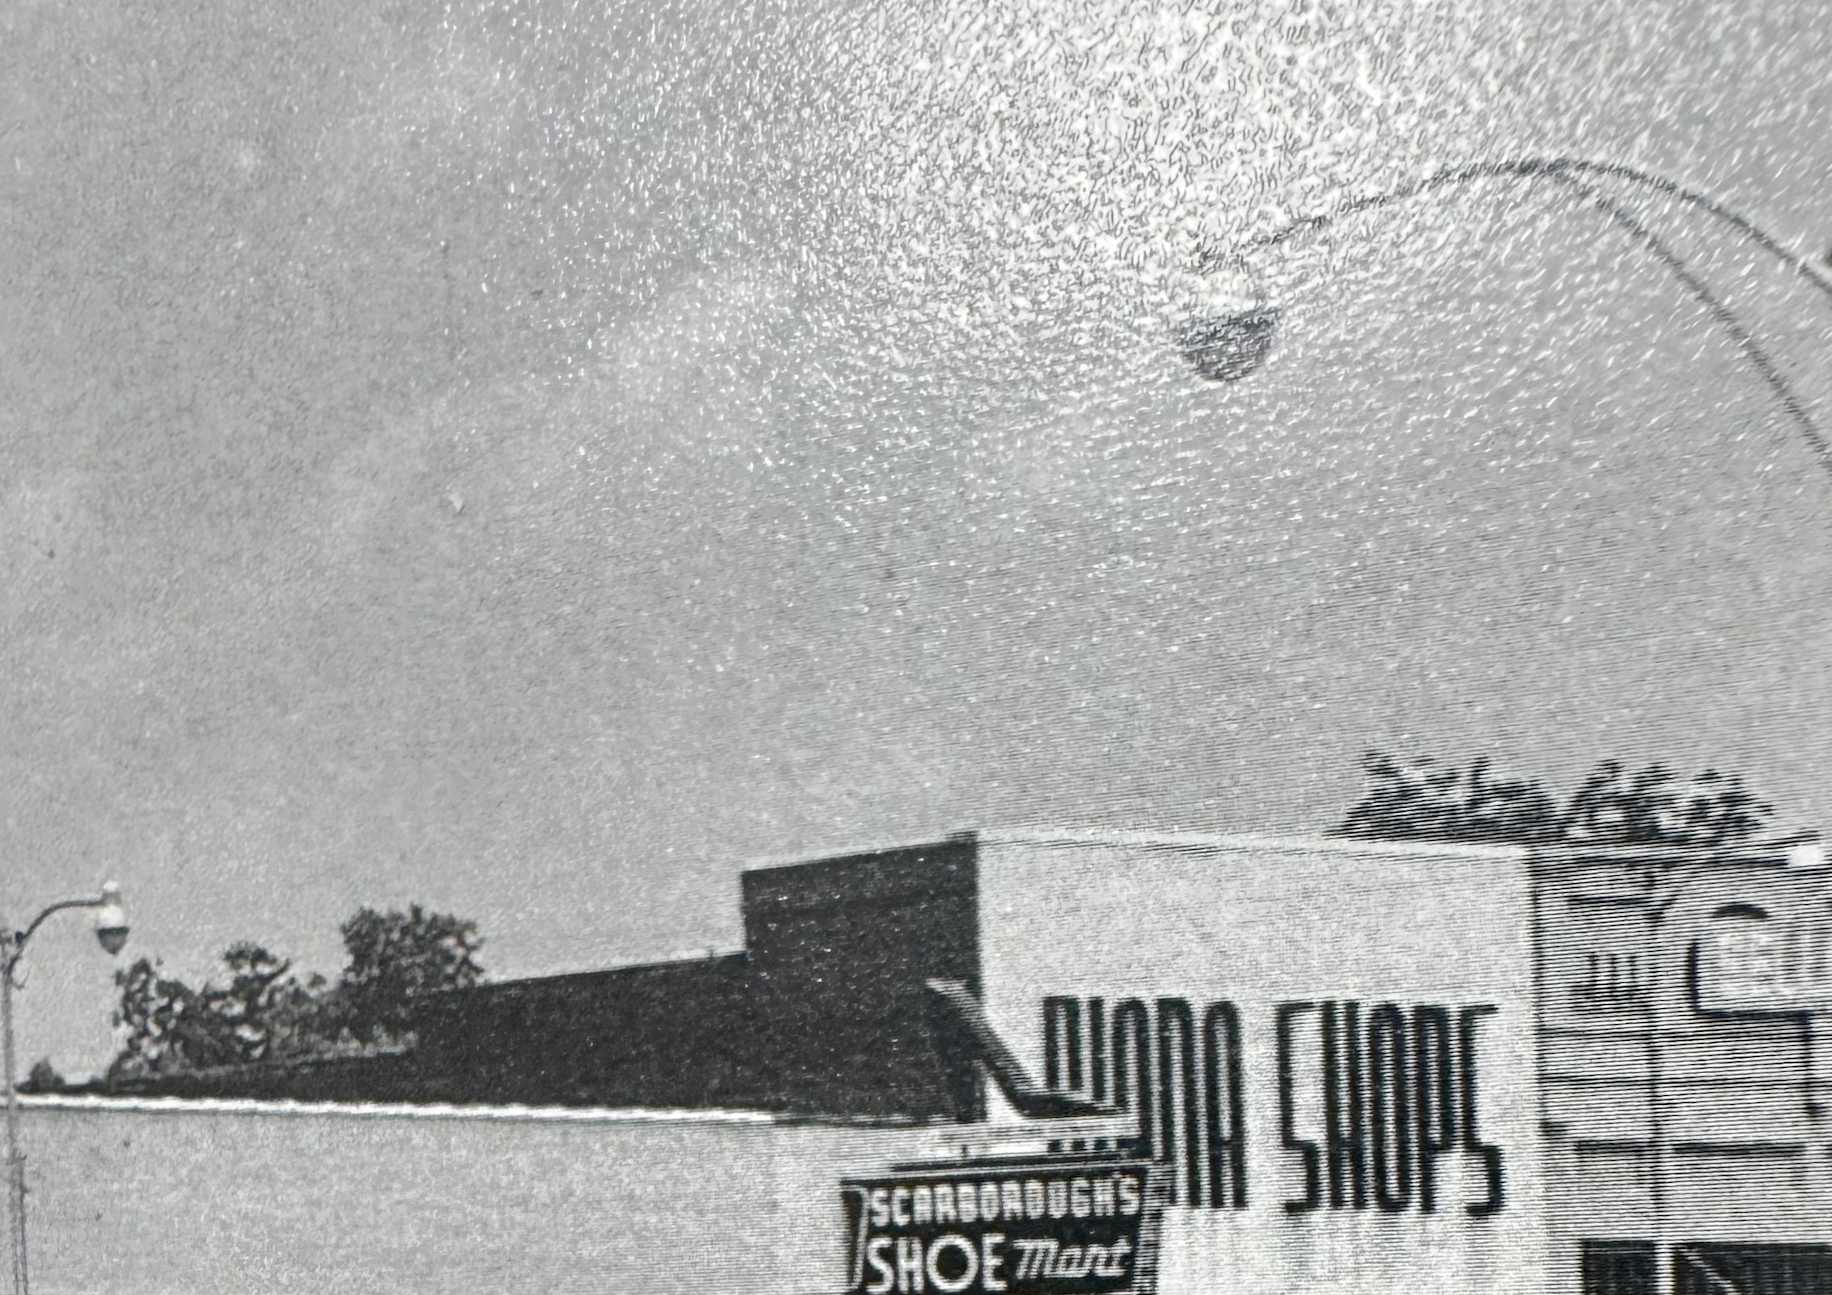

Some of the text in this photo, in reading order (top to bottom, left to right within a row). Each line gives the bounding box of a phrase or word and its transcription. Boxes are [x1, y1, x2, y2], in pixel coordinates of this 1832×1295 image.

[1275, 1000, 1505, 1216] SHOPS
[869, 1172, 1140, 1227] SCARBOROUGH'S
[865, 1231, 1133, 1295] SHOE Mart
